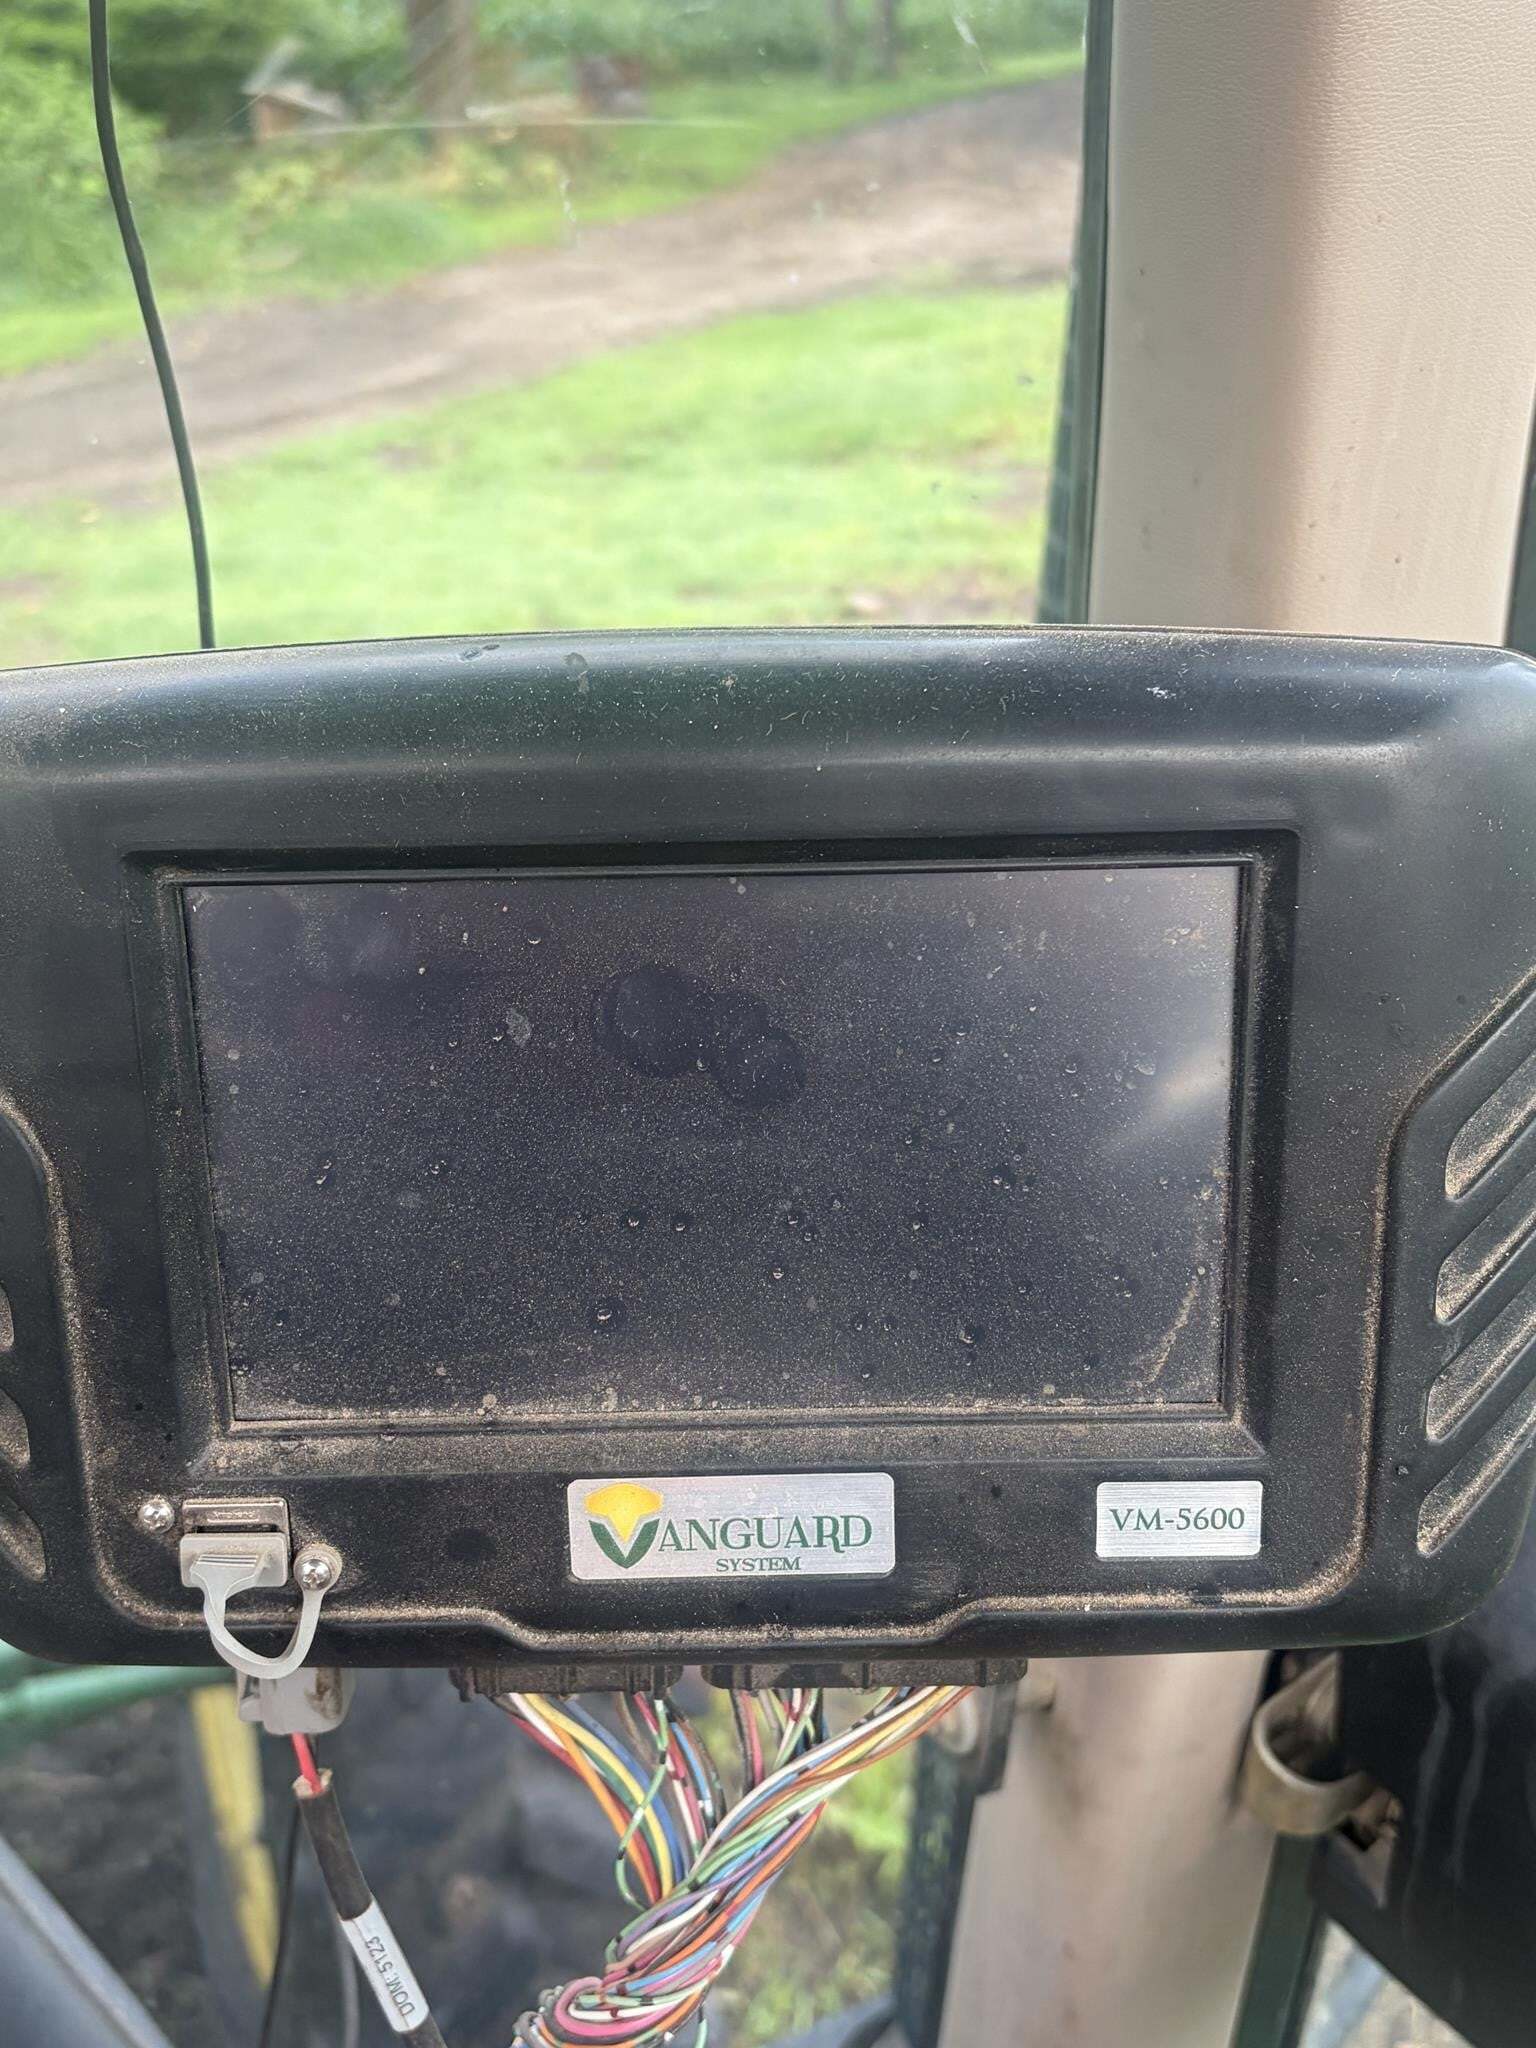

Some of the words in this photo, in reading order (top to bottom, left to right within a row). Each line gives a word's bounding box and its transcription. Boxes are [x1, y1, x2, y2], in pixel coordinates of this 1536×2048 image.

[1109, 1507, 1245, 1531] VM-5600
[588, 1514, 873, 1569] VANGUARD
[716, 1556, 801, 1572] SYSTEM
[365, 1936, 393, 1974] 5123
[386, 1972, 415, 2017] DOM:
